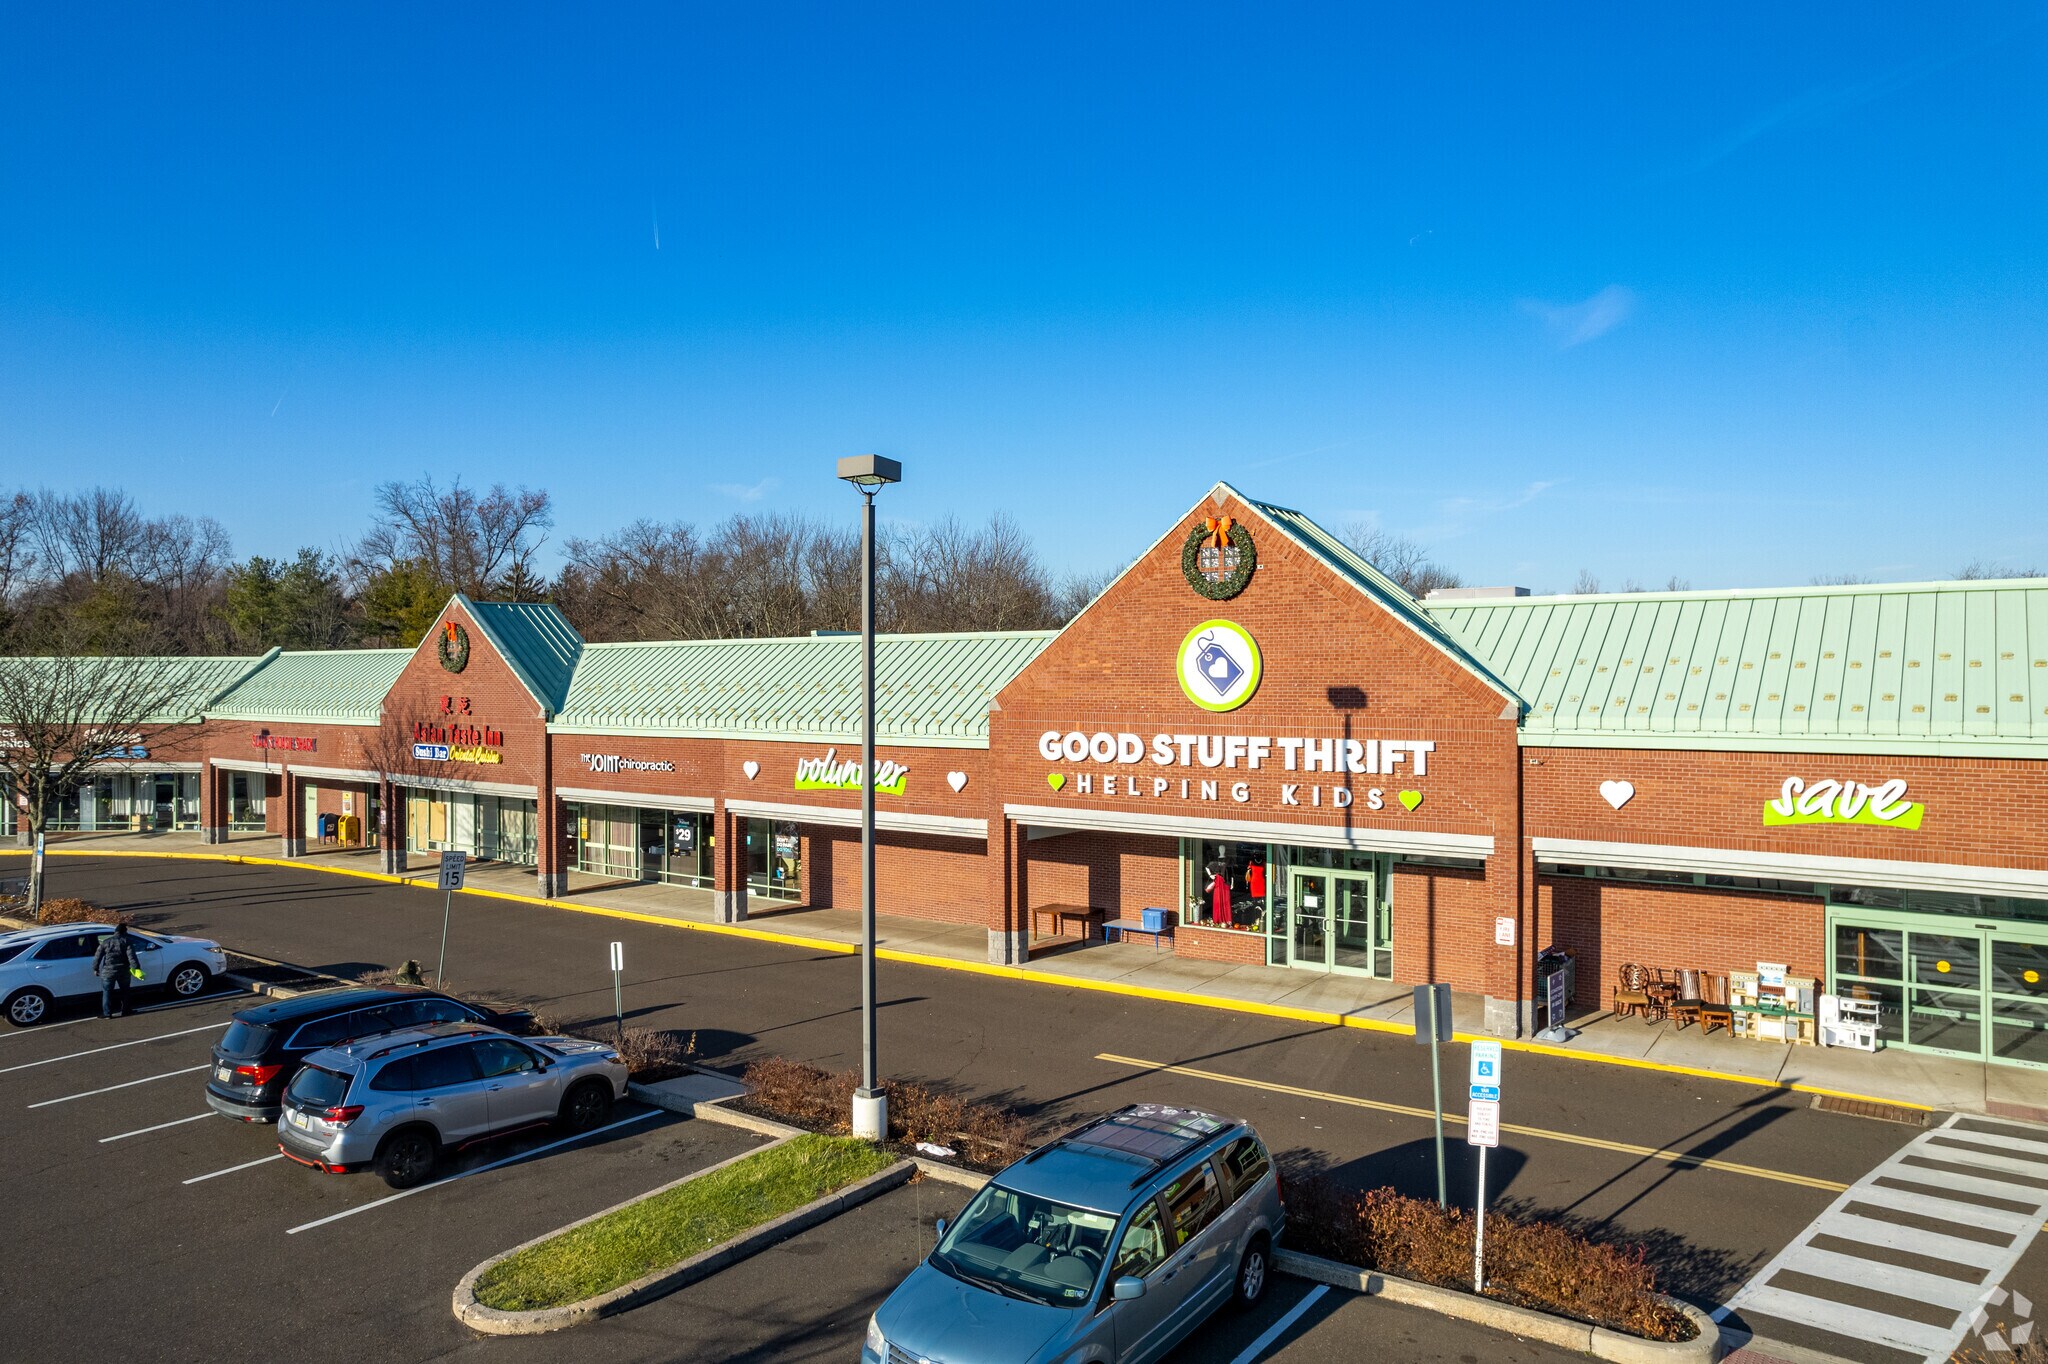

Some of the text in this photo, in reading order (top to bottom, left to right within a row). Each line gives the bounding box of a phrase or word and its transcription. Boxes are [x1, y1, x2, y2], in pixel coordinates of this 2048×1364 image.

[414, 722, 502, 747] Asian Taste Inn
[415, 746, 447, 759] Sushi Bar
[580, 753, 674, 773] THE JOINT chiropractic
[1038, 730, 1436, 777] GOOD STUFF THRIFT
[797, 747, 909, 788] voluner
[1077, 773, 1385, 810] HELPING KIDS
[1771, 776, 1912, 820] save
[675, 828, 691, 841] $29
[445, 871, 460, 886] 15
